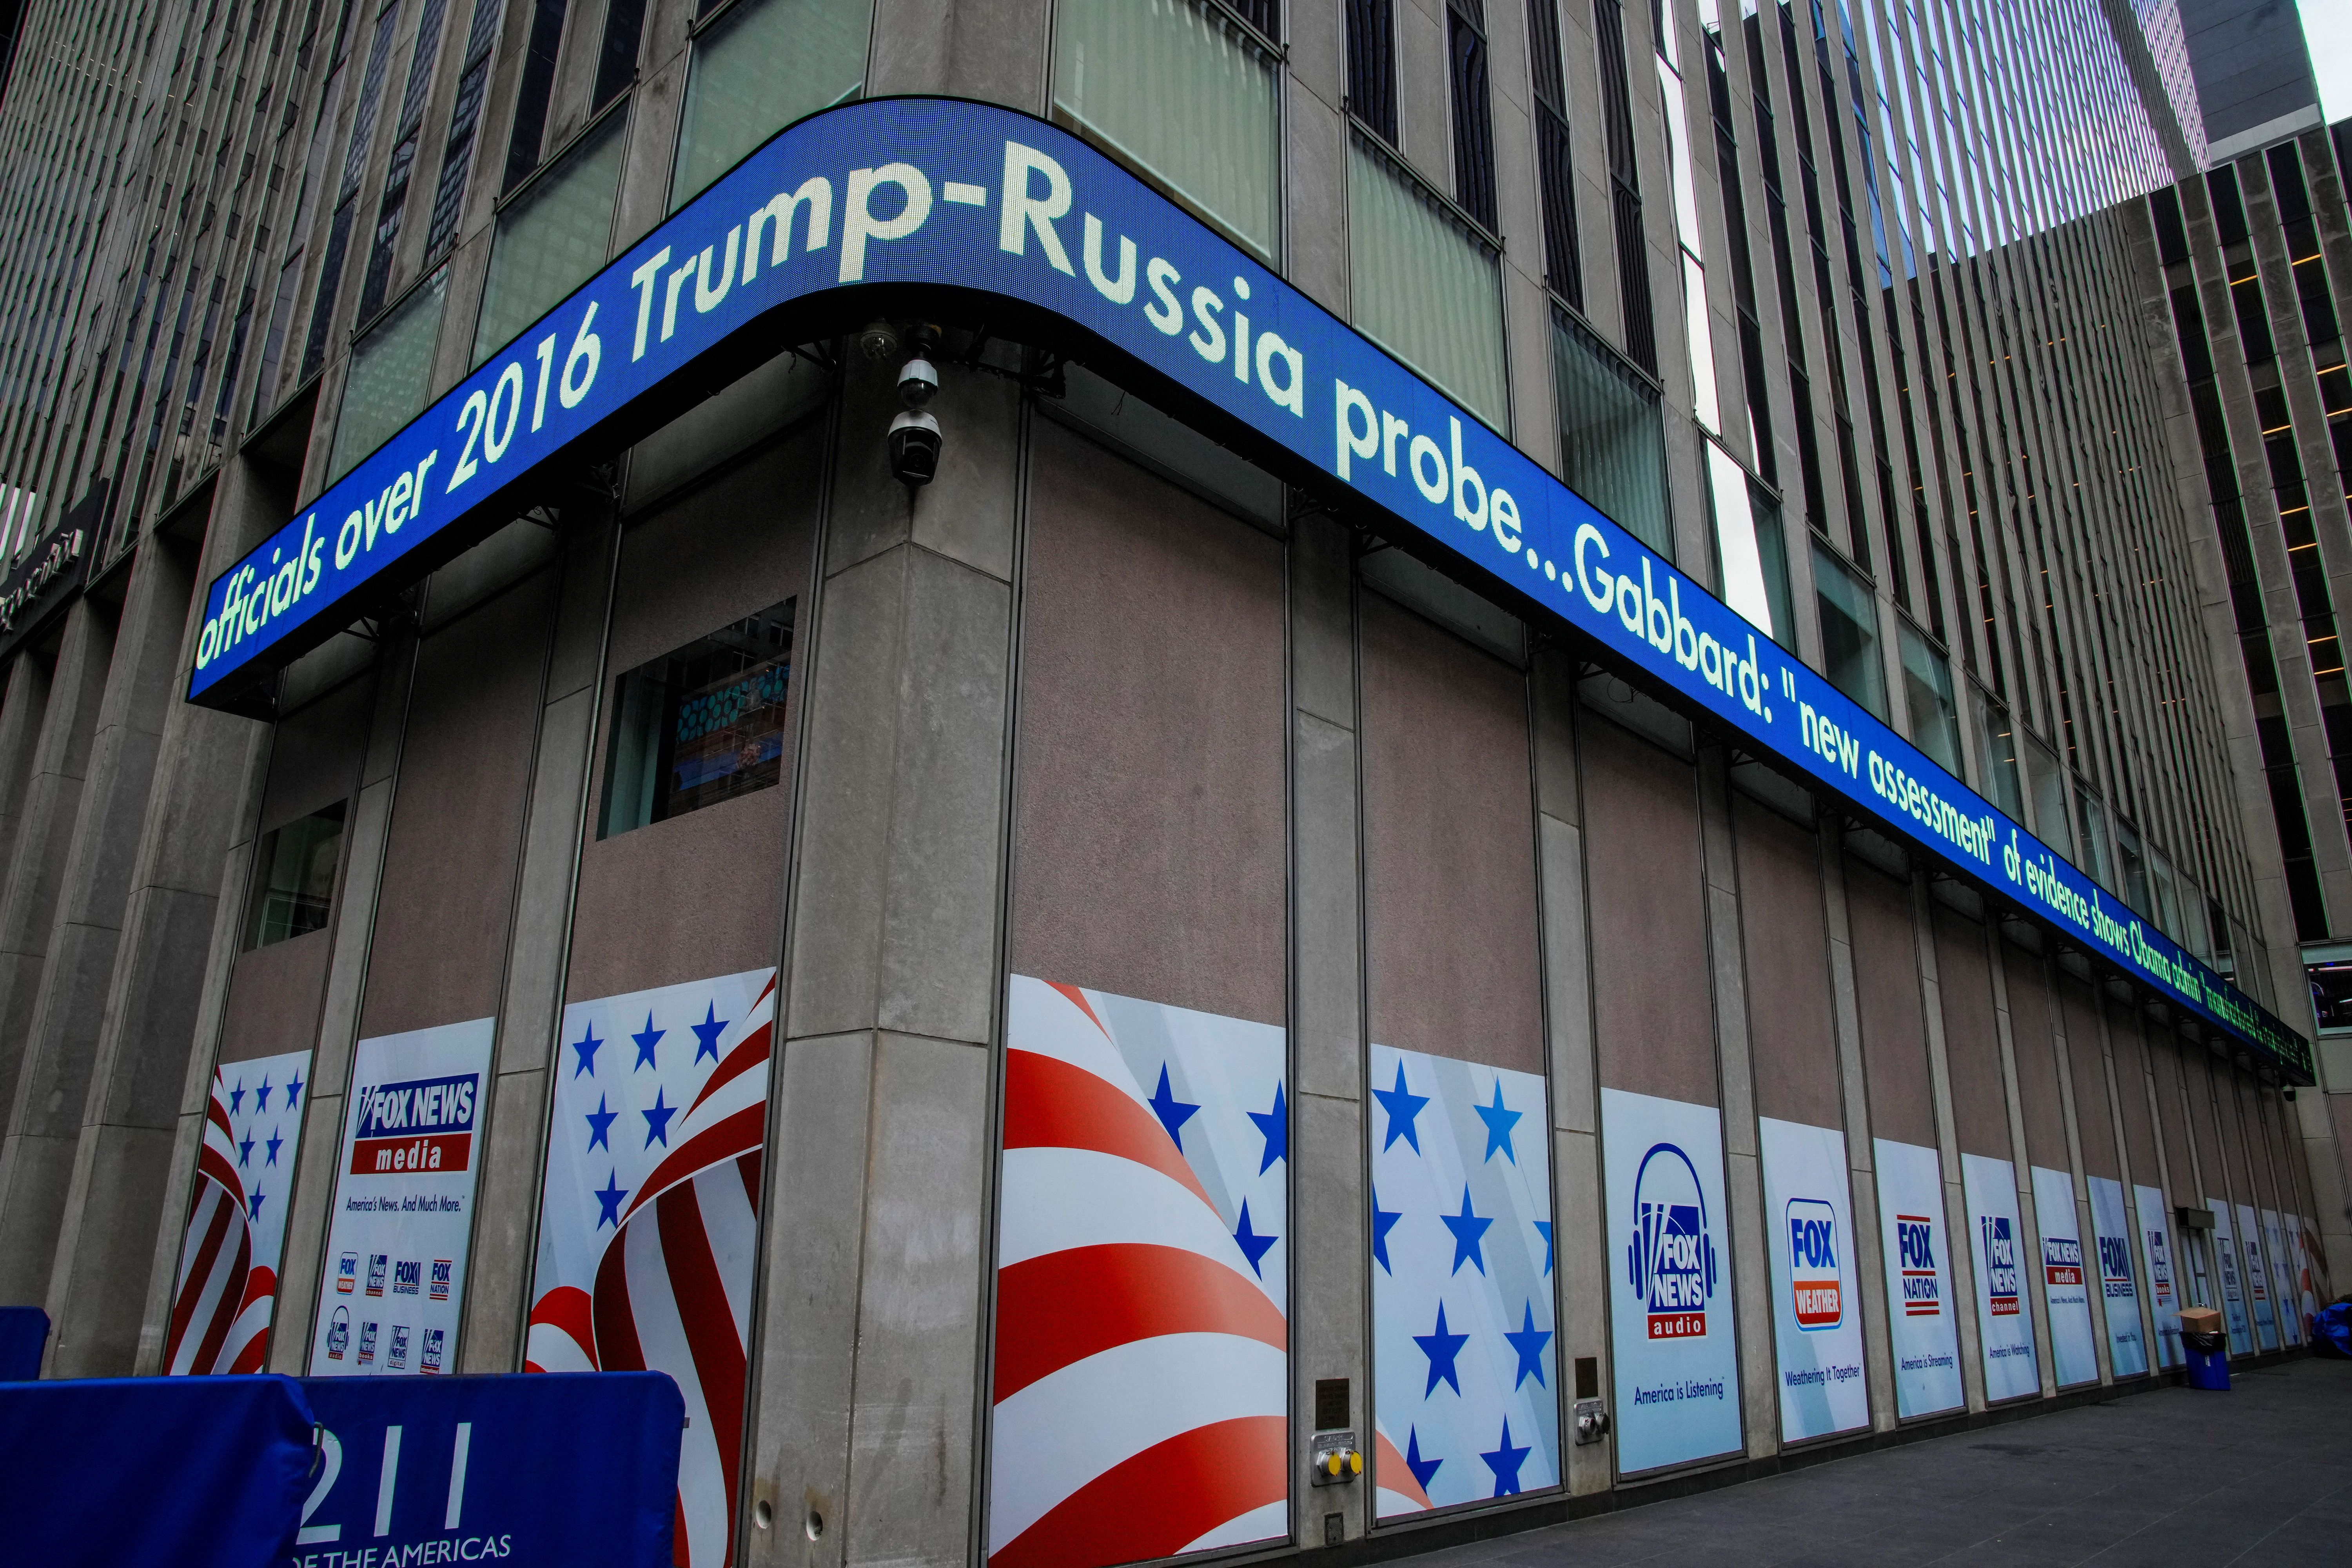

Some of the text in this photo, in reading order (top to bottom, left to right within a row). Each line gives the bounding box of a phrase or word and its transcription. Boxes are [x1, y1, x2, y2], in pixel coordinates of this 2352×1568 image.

[196, 512, 325, 670] officials
[335, 449, 437, 570] over
[446, 301, 601, 494] 2016
[631, 139, 1303, 419] Trump-Russia
[1781, 666, 1859, 779] "new
[1869, 750, 1996, 866] assessment"
[2004, 828, 2022, 886] of
[2025, 853, 2089, 929] evidence
[2091, 888, 2130, 956] shows
[2129, 920, 2172, 984] Obama
[2172, 951, 2202, 1004] admin
[370, 1081, 474, 1130] FOX NEWS
[376, 1139, 441, 1170] media
[346, 1194, 461, 1212] America's News. And Much More.
[1791, 1218, 1836, 1268] FOX
[1897, 1223, 1935, 1268] FOX
[1993, 1238, 2013, 1265] FOX
[1662, 1234, 1700, 1270] FOX
[2047, 1241, 2078, 1263] FOX NEWS
[2099, 1236, 2127, 1278] FOX
[2154, 1245, 2165, 1262] FOX
[340, 1258, 356, 1275] FOX
[373, 1263, 385, 1276] FOX
[394, 1261, 418, 1283] FOX
[432, 1263, 452, 1281] FOX
[2156, 1265, 2168, 1280] NEWS
[369, 1276, 384, 1287] NEWS
[1991, 1268, 2016, 1292] NEWS
[2054, 1269, 2075, 1283] media
[338, 1280, 353, 1290] WEATHER
[393, 1285, 419, 1295] BUSINESS
[430, 1284, 449, 1294] NATION
[1654, 1273, 1702, 1307] NEWS
[1903, 1278, 1938, 1299] NATION
[2105, 1283, 2133, 1297] BUSINESS
[2156, 1284, 2169, 1293] books
[1796, 1289, 1839, 1315] WEATHER
[1991, 1301, 2019, 1312] channel
[1654, 1316, 1701, 1335] audio
[336, 1330, 345, 1341] FOX
[365, 1330, 376, 1341] FOX
[396, 1336, 407, 1348] FOX
[331, 1341, 345, 1352] NEWS
[361, 1341, 375, 1352] NEWS
[392, 1347, 406, 1359] NEWS
[428, 1339, 442, 1352] FOX
[1989, 1342, 2030, 1359] America is Watching
[424, 1352, 441, 1365] NEWS
[1901, 1354, 1953, 1371] America is Streaming
[1785, 1363, 1860, 1386] Weathering It Together
[1634, 1377, 1723, 1405] America is Listening
[323, 1547, 378, 1568] THE
[380, 1534, 511, 1568] AMERICAS
